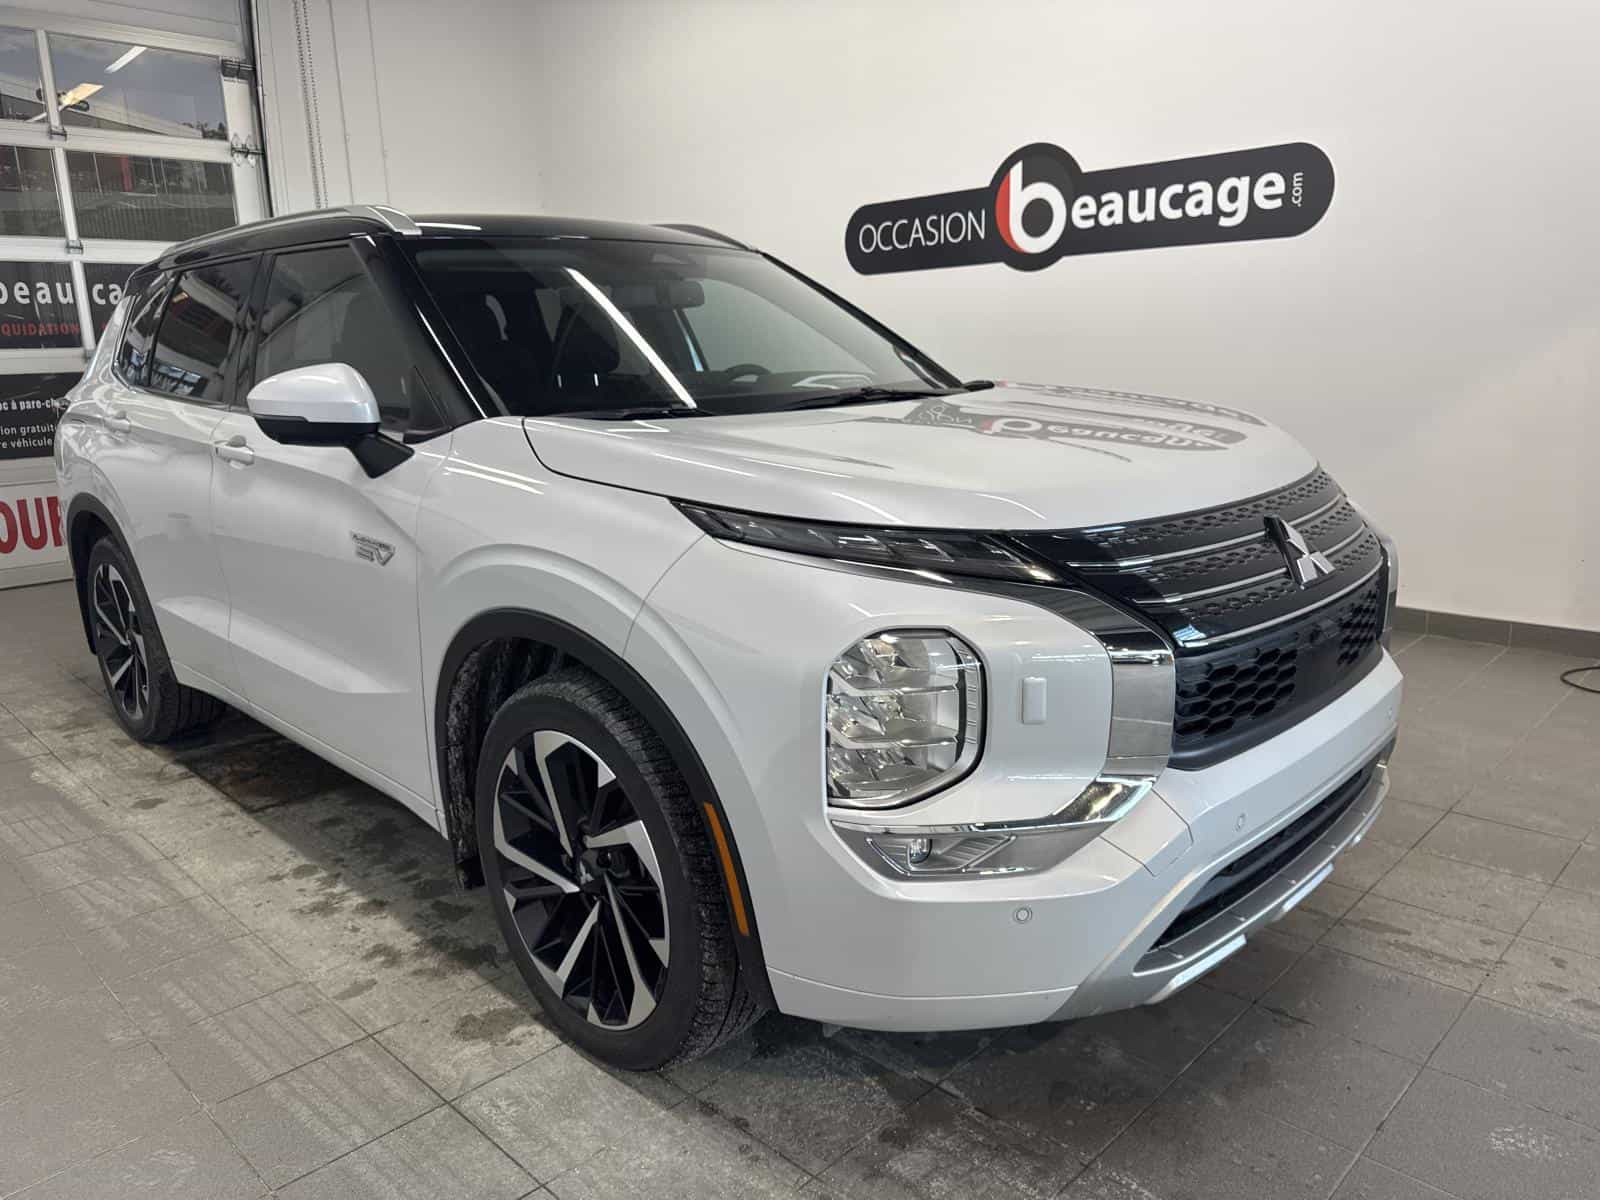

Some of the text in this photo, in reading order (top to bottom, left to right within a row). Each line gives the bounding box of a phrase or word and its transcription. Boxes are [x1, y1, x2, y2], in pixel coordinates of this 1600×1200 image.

[859, 160, 1304, 254] OCCASION beaucage .com
